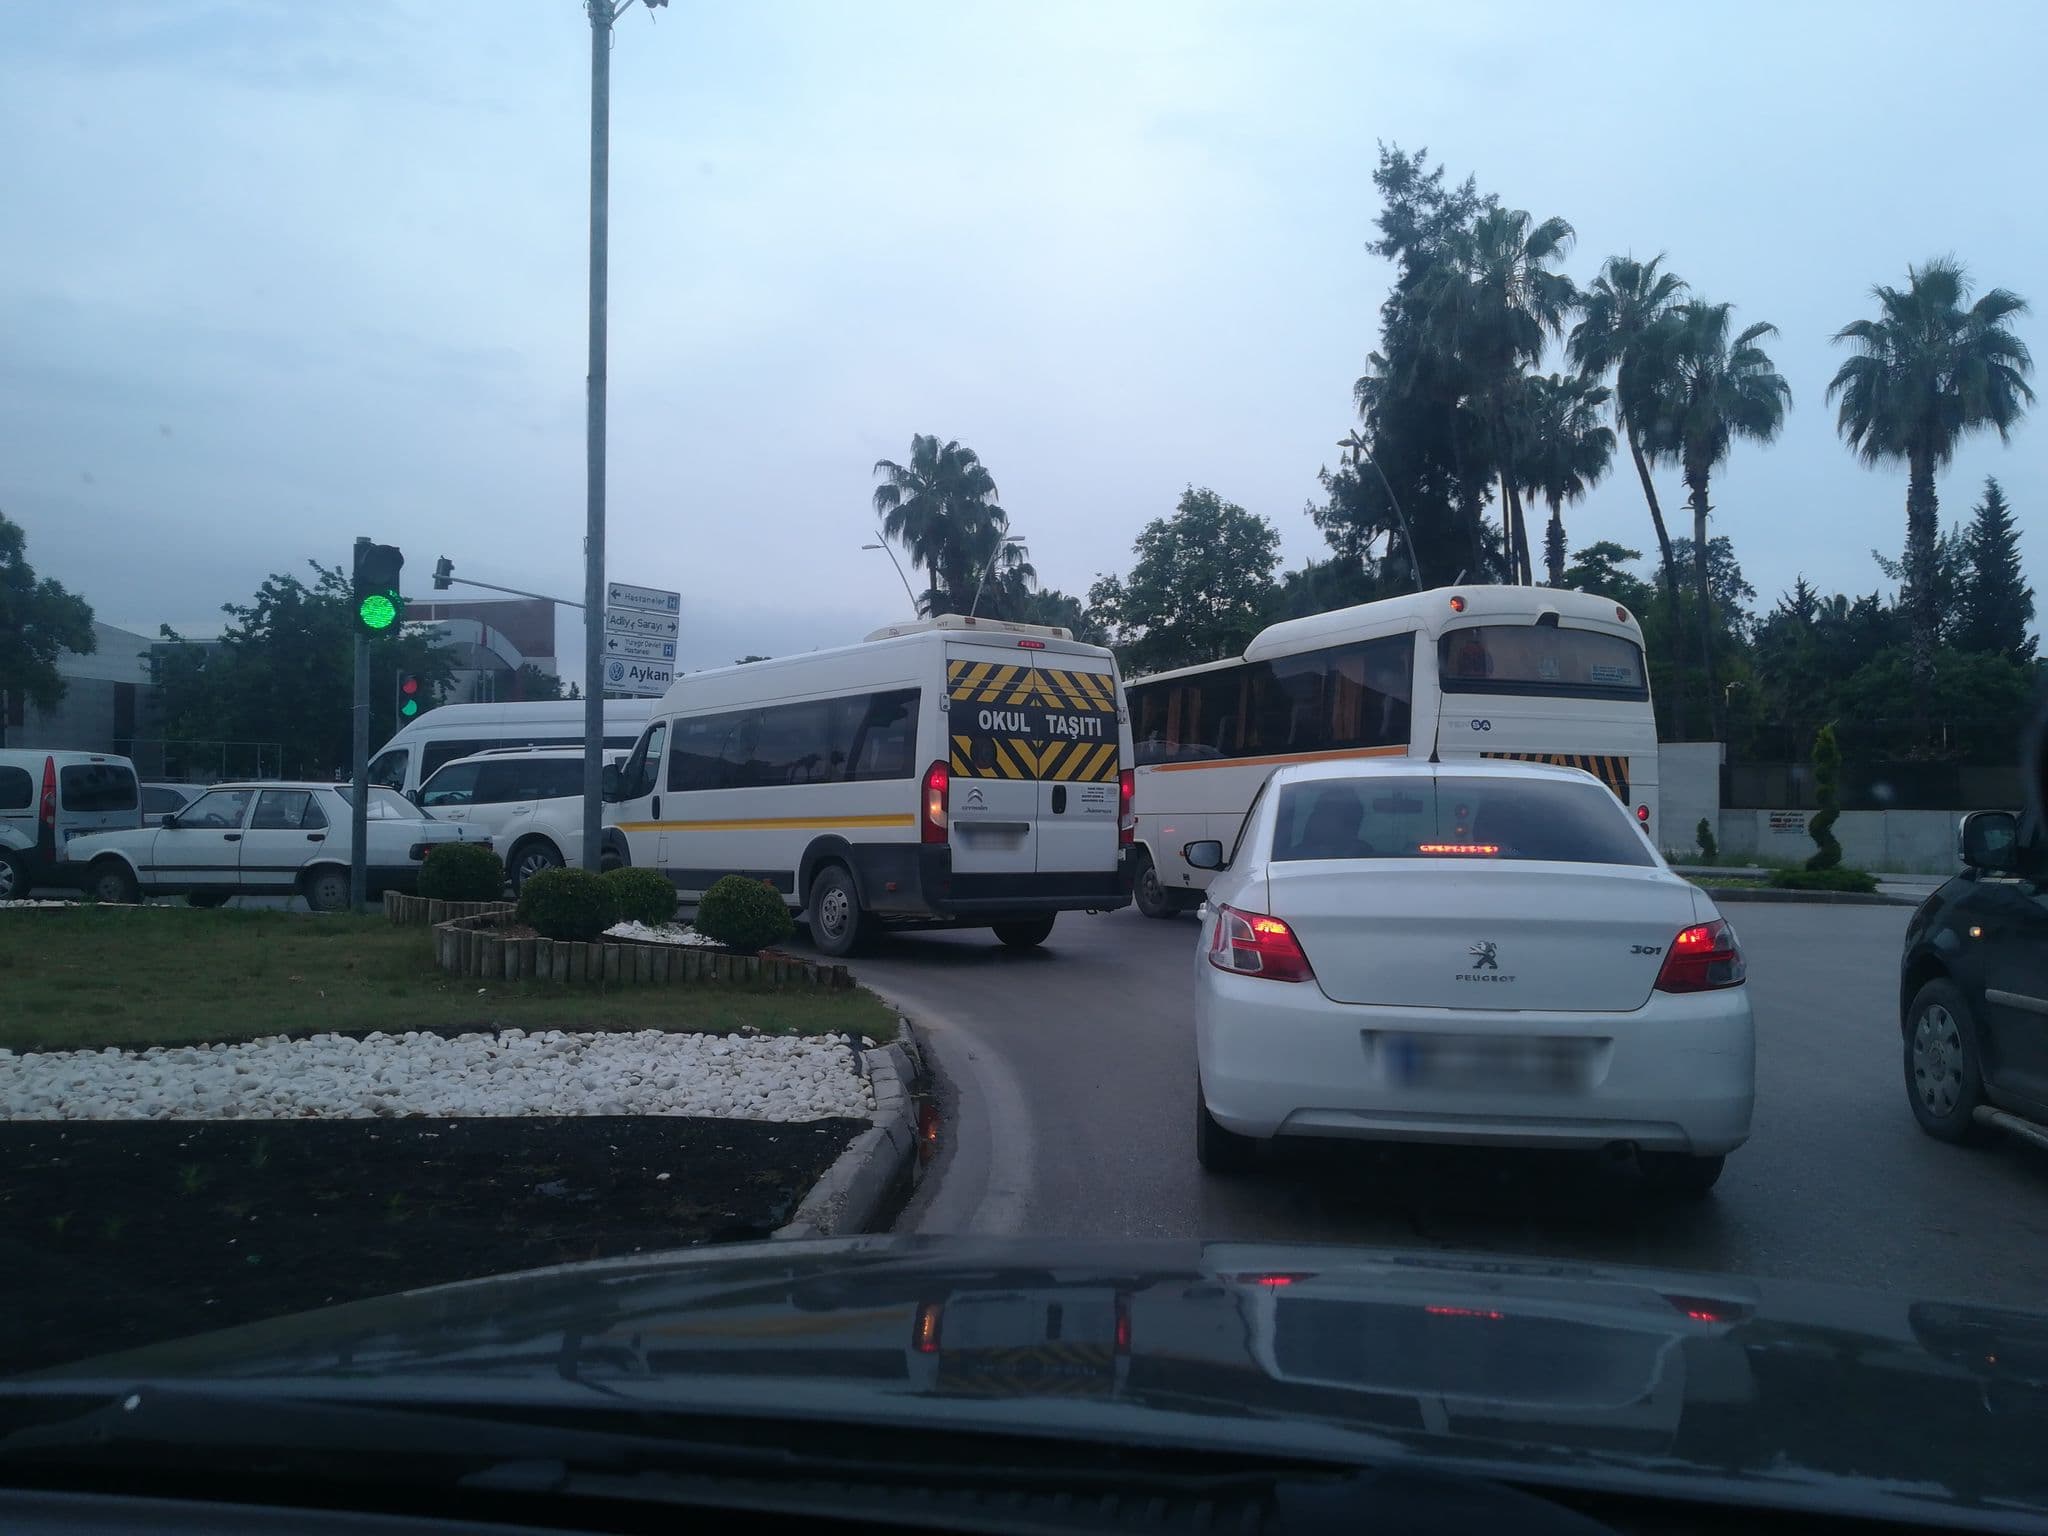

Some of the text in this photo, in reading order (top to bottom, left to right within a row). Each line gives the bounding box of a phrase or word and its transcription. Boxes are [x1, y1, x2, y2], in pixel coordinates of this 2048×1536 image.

[624, 592, 666, 605] Hastaneler
[629, 665, 669, 682] Aykan
[978, 710, 1102, 739] OKUL TAŞITI
[1630, 945, 1662, 955] 301
[1455, 974, 1515, 983] PEUGEOT
